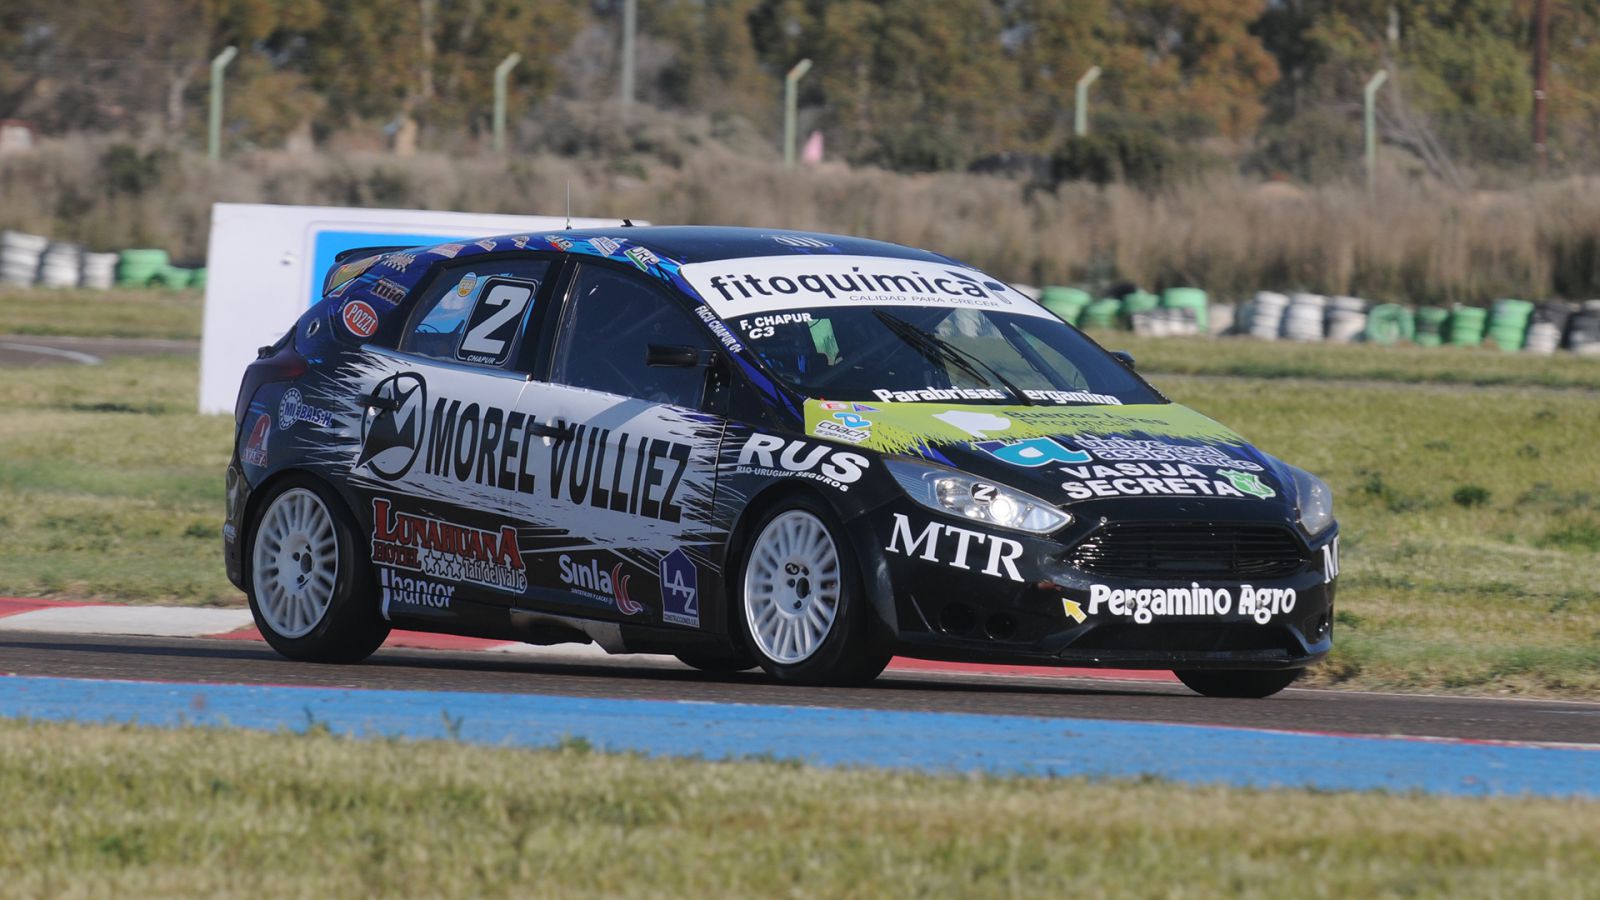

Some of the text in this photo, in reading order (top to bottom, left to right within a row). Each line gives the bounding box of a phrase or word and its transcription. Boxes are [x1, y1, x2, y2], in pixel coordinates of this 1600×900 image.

[710, 267, 989, 301] fitoquímica
[950, 297, 1000, 307] CRECER
[346, 304, 376, 334] POZZI
[461, 284, 531, 354] 2
[694, 305, 713, 321] FACU
[708, 320, 736, 347] CHAPUR
[740, 312, 813, 331] F. CHAPUR
[749, 326, 775, 339] C3
[467, 354, 496, 364] CHAPUR
[872, 386, 1005, 403] Parabrisas
[818, 421, 869, 440] coach
[425, 397, 692, 523] MOREL VULLIEZ
[737, 432, 870, 483] RUS
[1059, 463, 1208, 479] VASIJA
[796, 471, 849, 492] SEGUROS
[1061, 478, 1245, 499] SECRETA
[885, 512, 1025, 583] MTR
[373, 541, 422, 569] HOTEL
[483, 564, 500, 584] del
[500, 567, 526, 590] Valle
[559, 554, 613, 595] Sinla
[392, 570, 455, 608] bancor
[1088, 582, 1296, 625] Pergamino Agro
